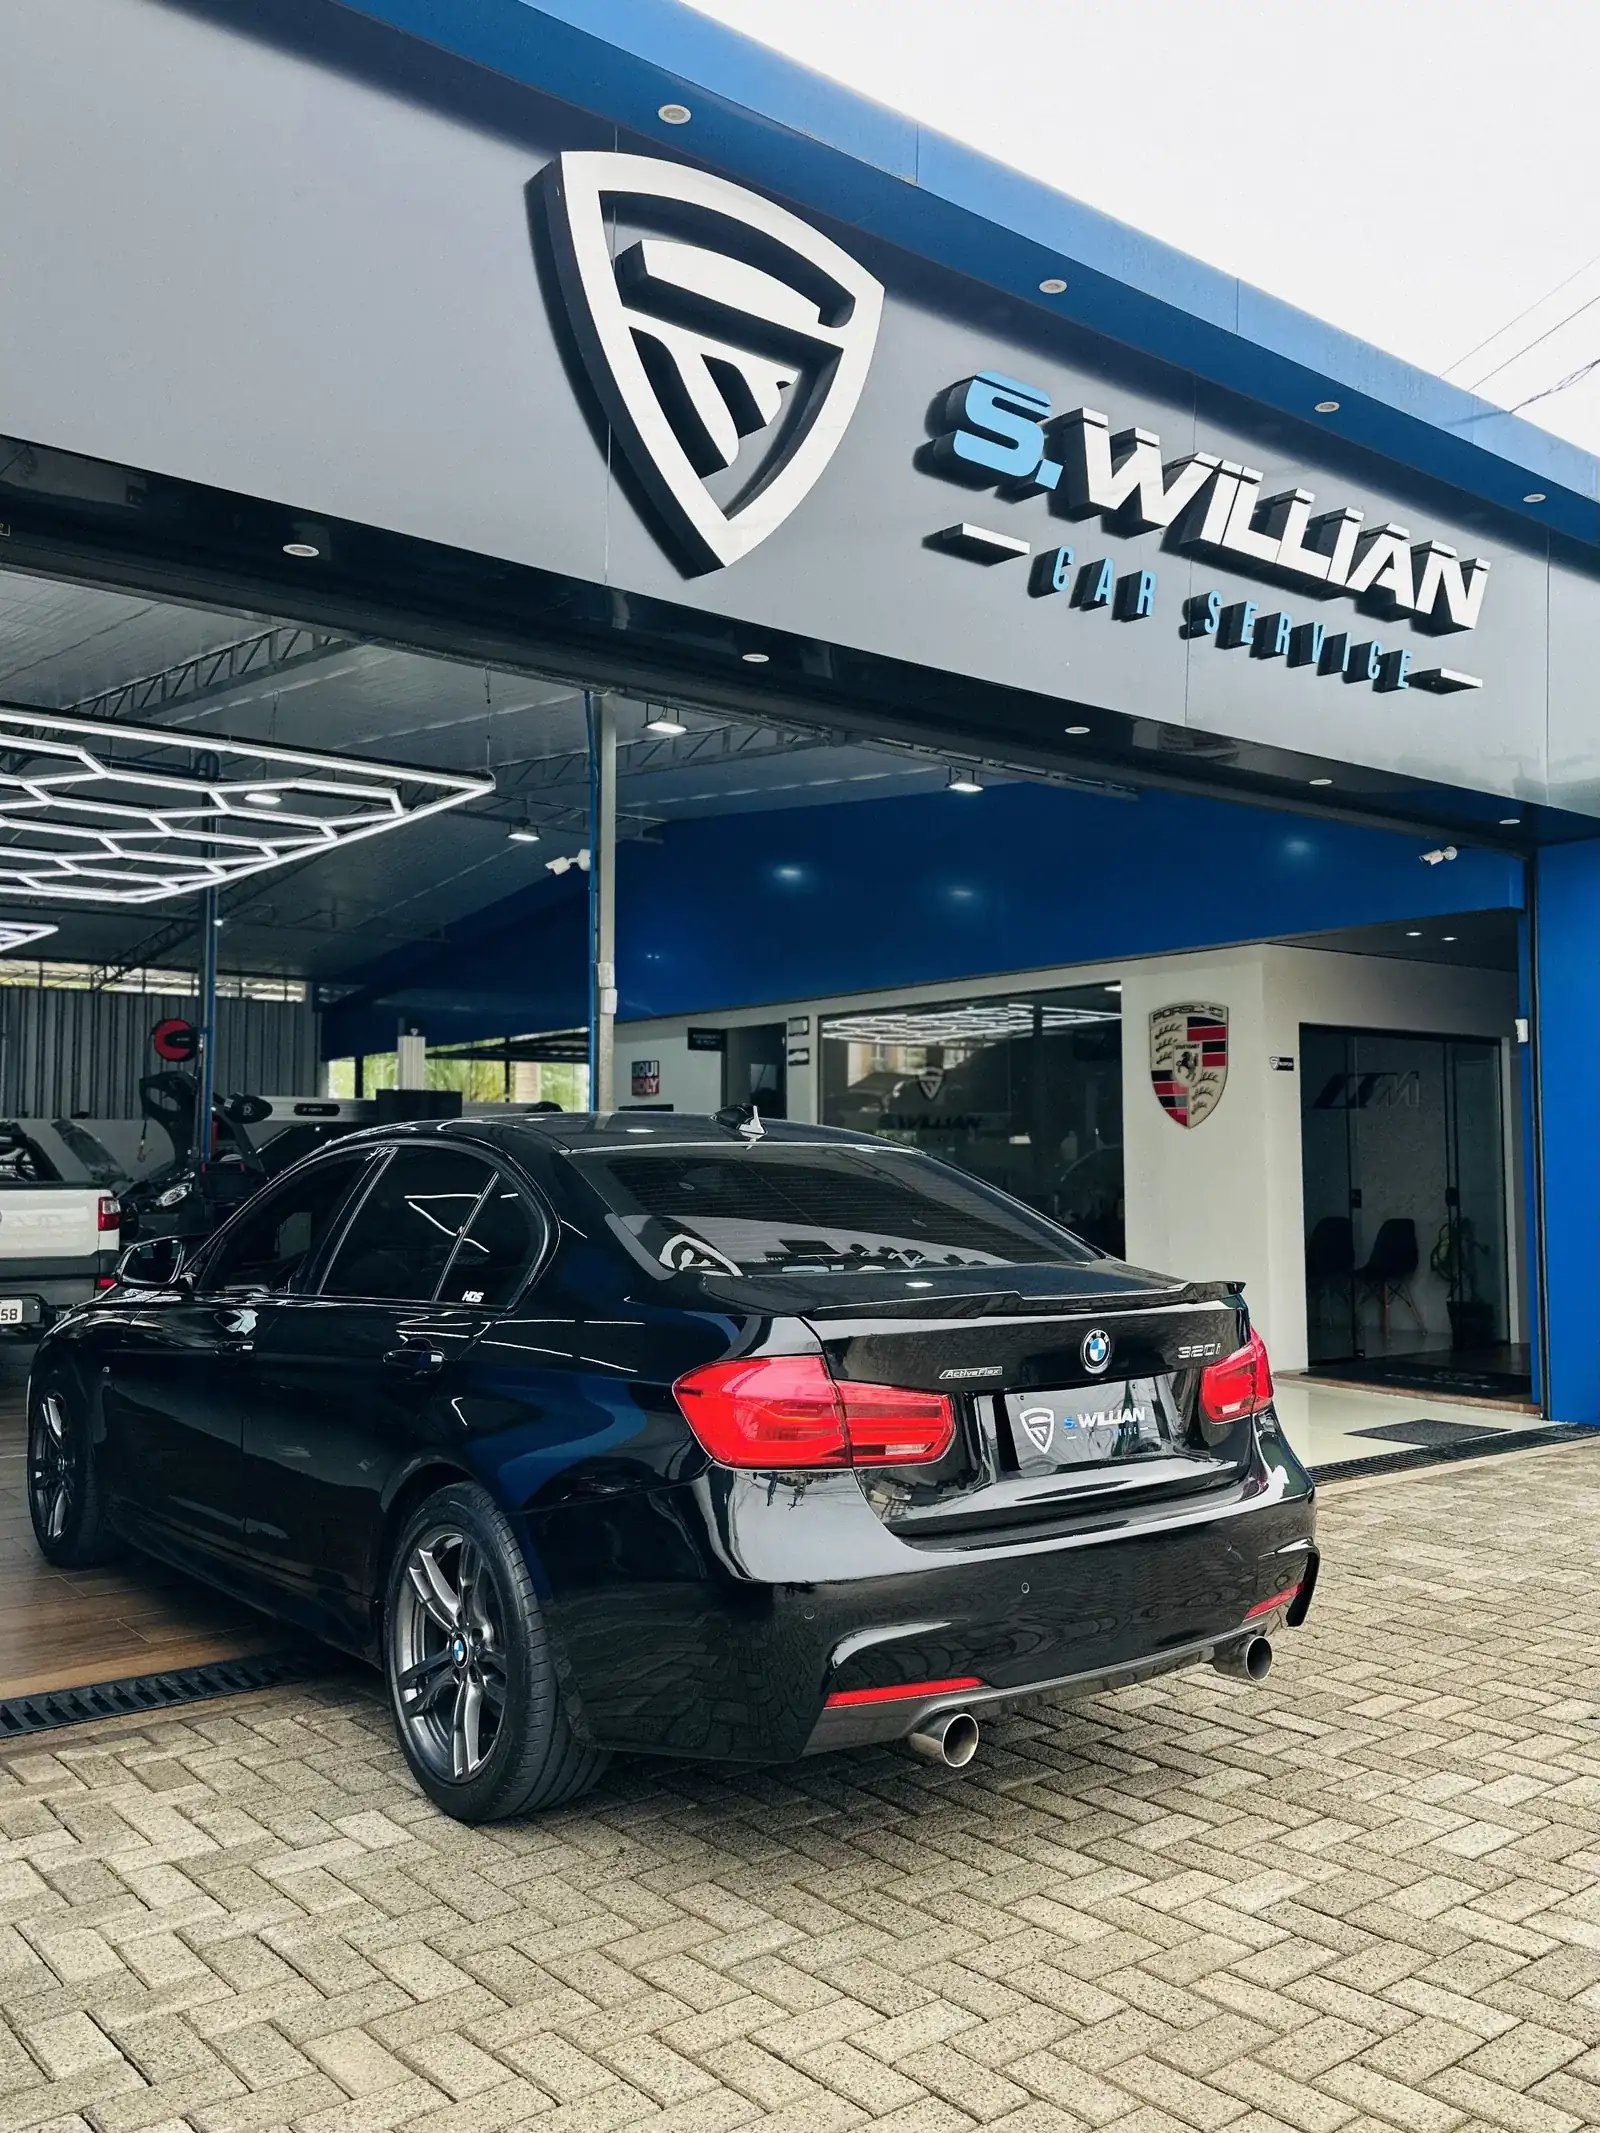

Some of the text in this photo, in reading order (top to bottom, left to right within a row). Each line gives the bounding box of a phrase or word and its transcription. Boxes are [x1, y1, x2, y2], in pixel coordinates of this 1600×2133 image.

[1052, 544, 1414, 689] CAR SERVICE
[1177, 1342, 1222, 1359] 320i
[945, 1367, 1001, 1379] ActiveFlex
